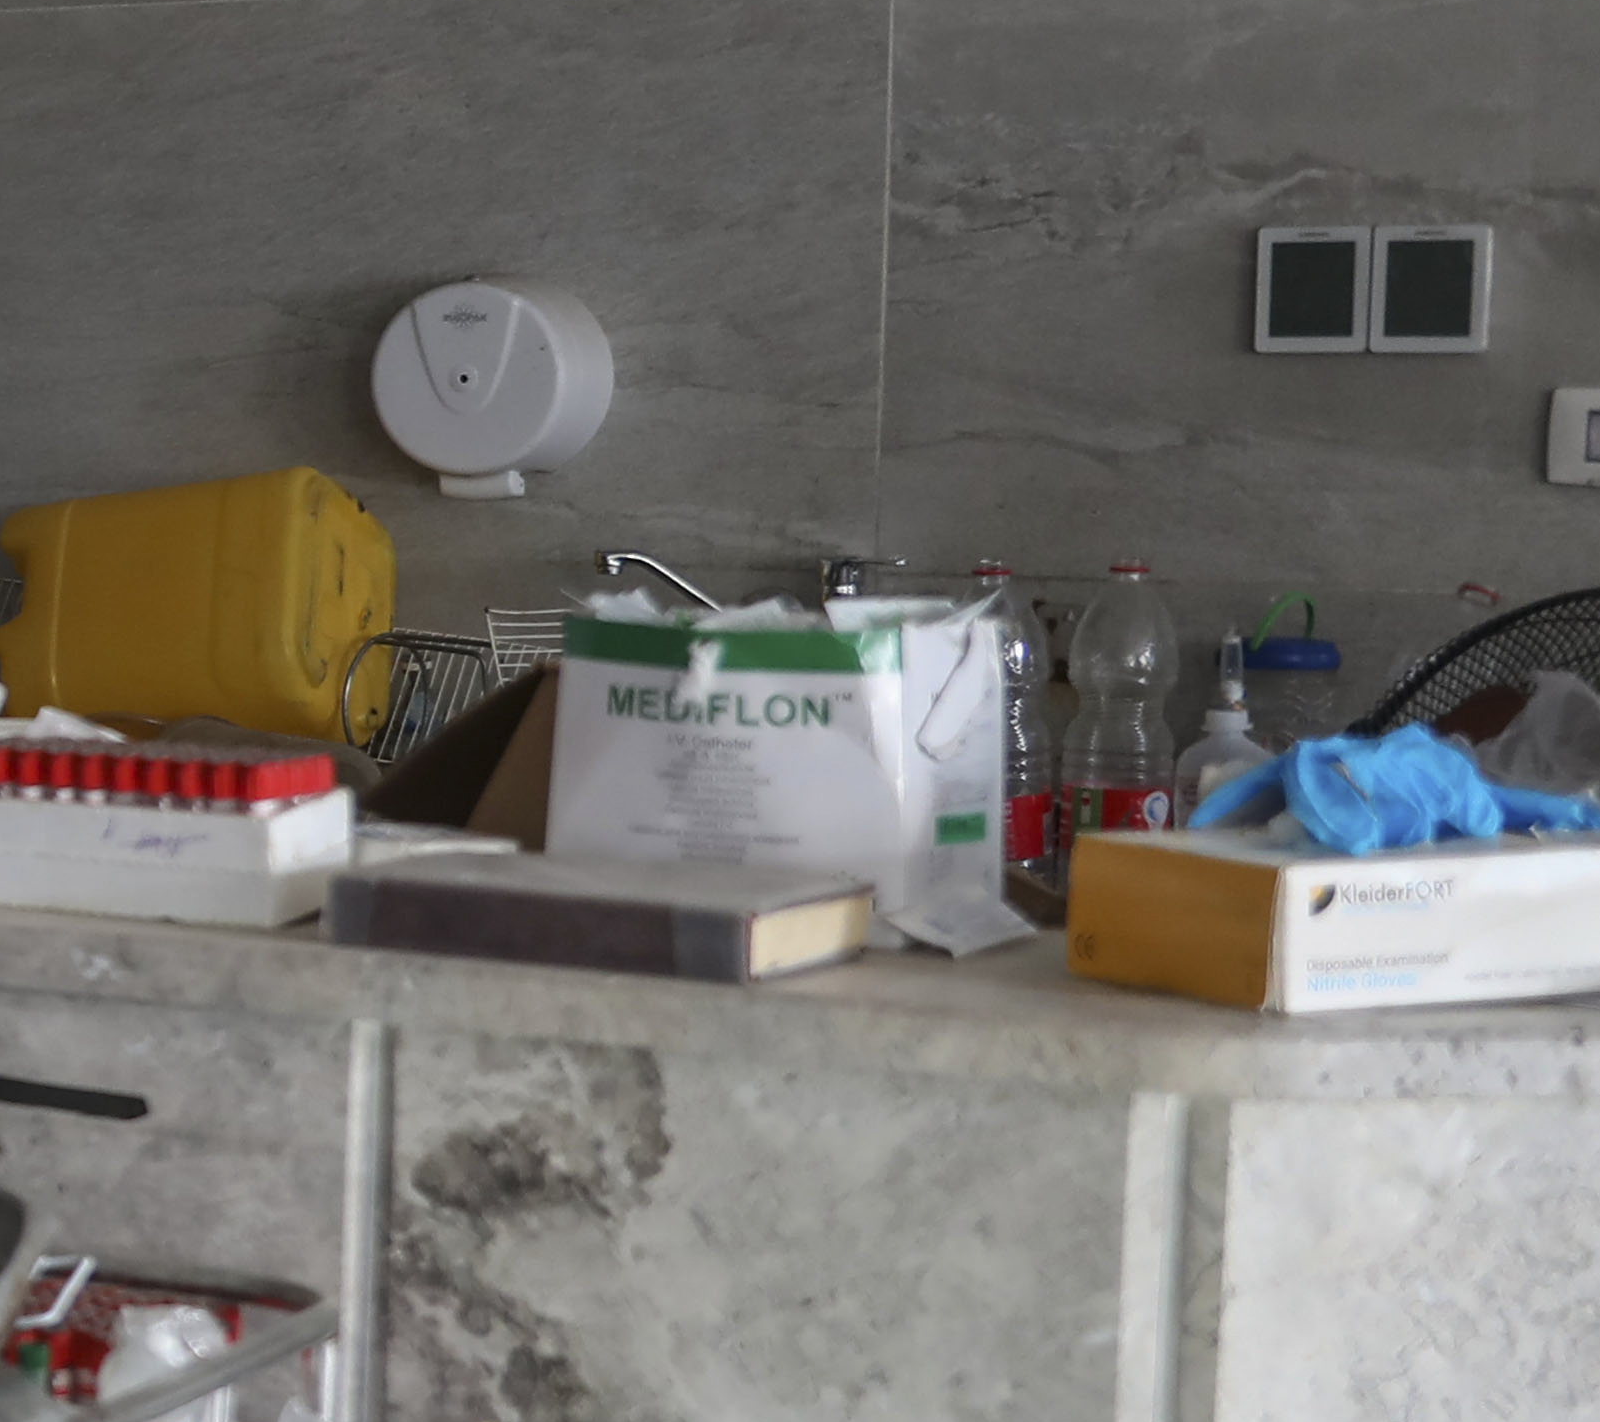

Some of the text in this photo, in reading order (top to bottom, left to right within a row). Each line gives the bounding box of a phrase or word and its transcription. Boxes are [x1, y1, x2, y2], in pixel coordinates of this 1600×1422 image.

[1338, 878, 1454, 906] KleiderFORT
[1305, 952, 1449, 974] Disposable Examination
[1306, 971, 1418, 992] Nitrile Gloves
